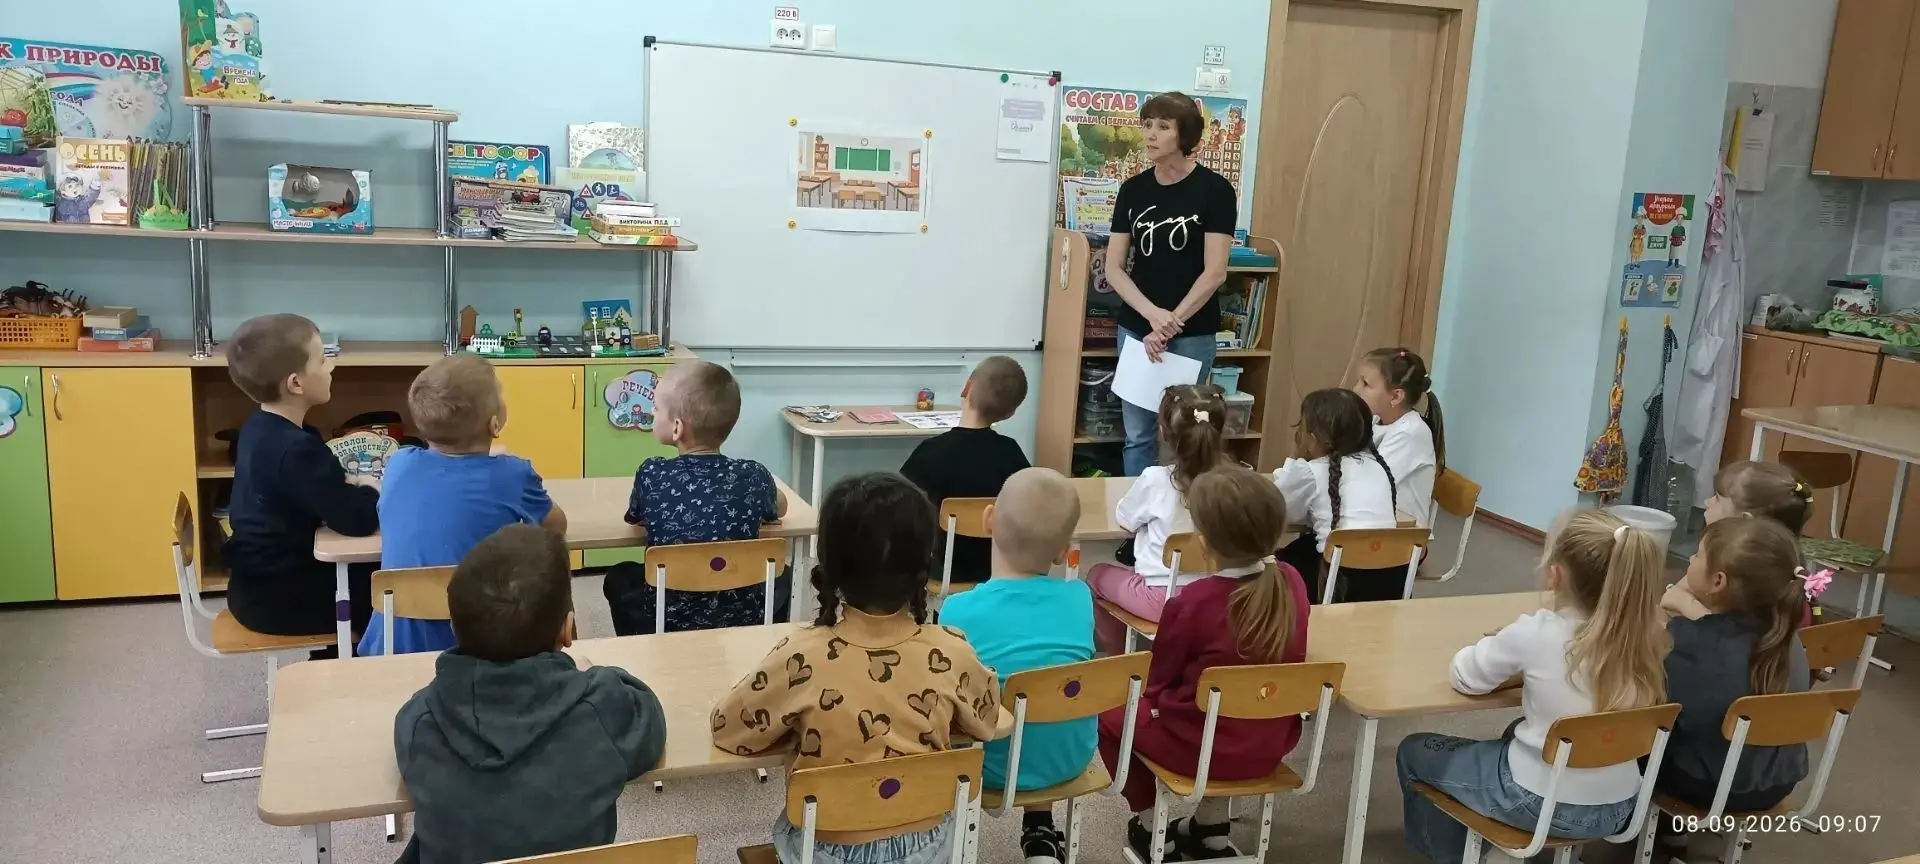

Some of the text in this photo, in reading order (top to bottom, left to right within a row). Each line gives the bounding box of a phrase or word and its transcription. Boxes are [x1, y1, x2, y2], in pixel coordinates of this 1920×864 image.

[777, 9, 790, 17] 220
[26, 45, 161, 72] ПРИРОДЫ
[1065, 89, 1138, 111] СОСТАВ
[1065, 115, 1098, 124] СЧИТАЕМ
[60, 143, 126, 161] ОСЕНЬ
[1128, 205, 1202, 257] Voyage
[333, 437, 367, 450] УГОЛОК
